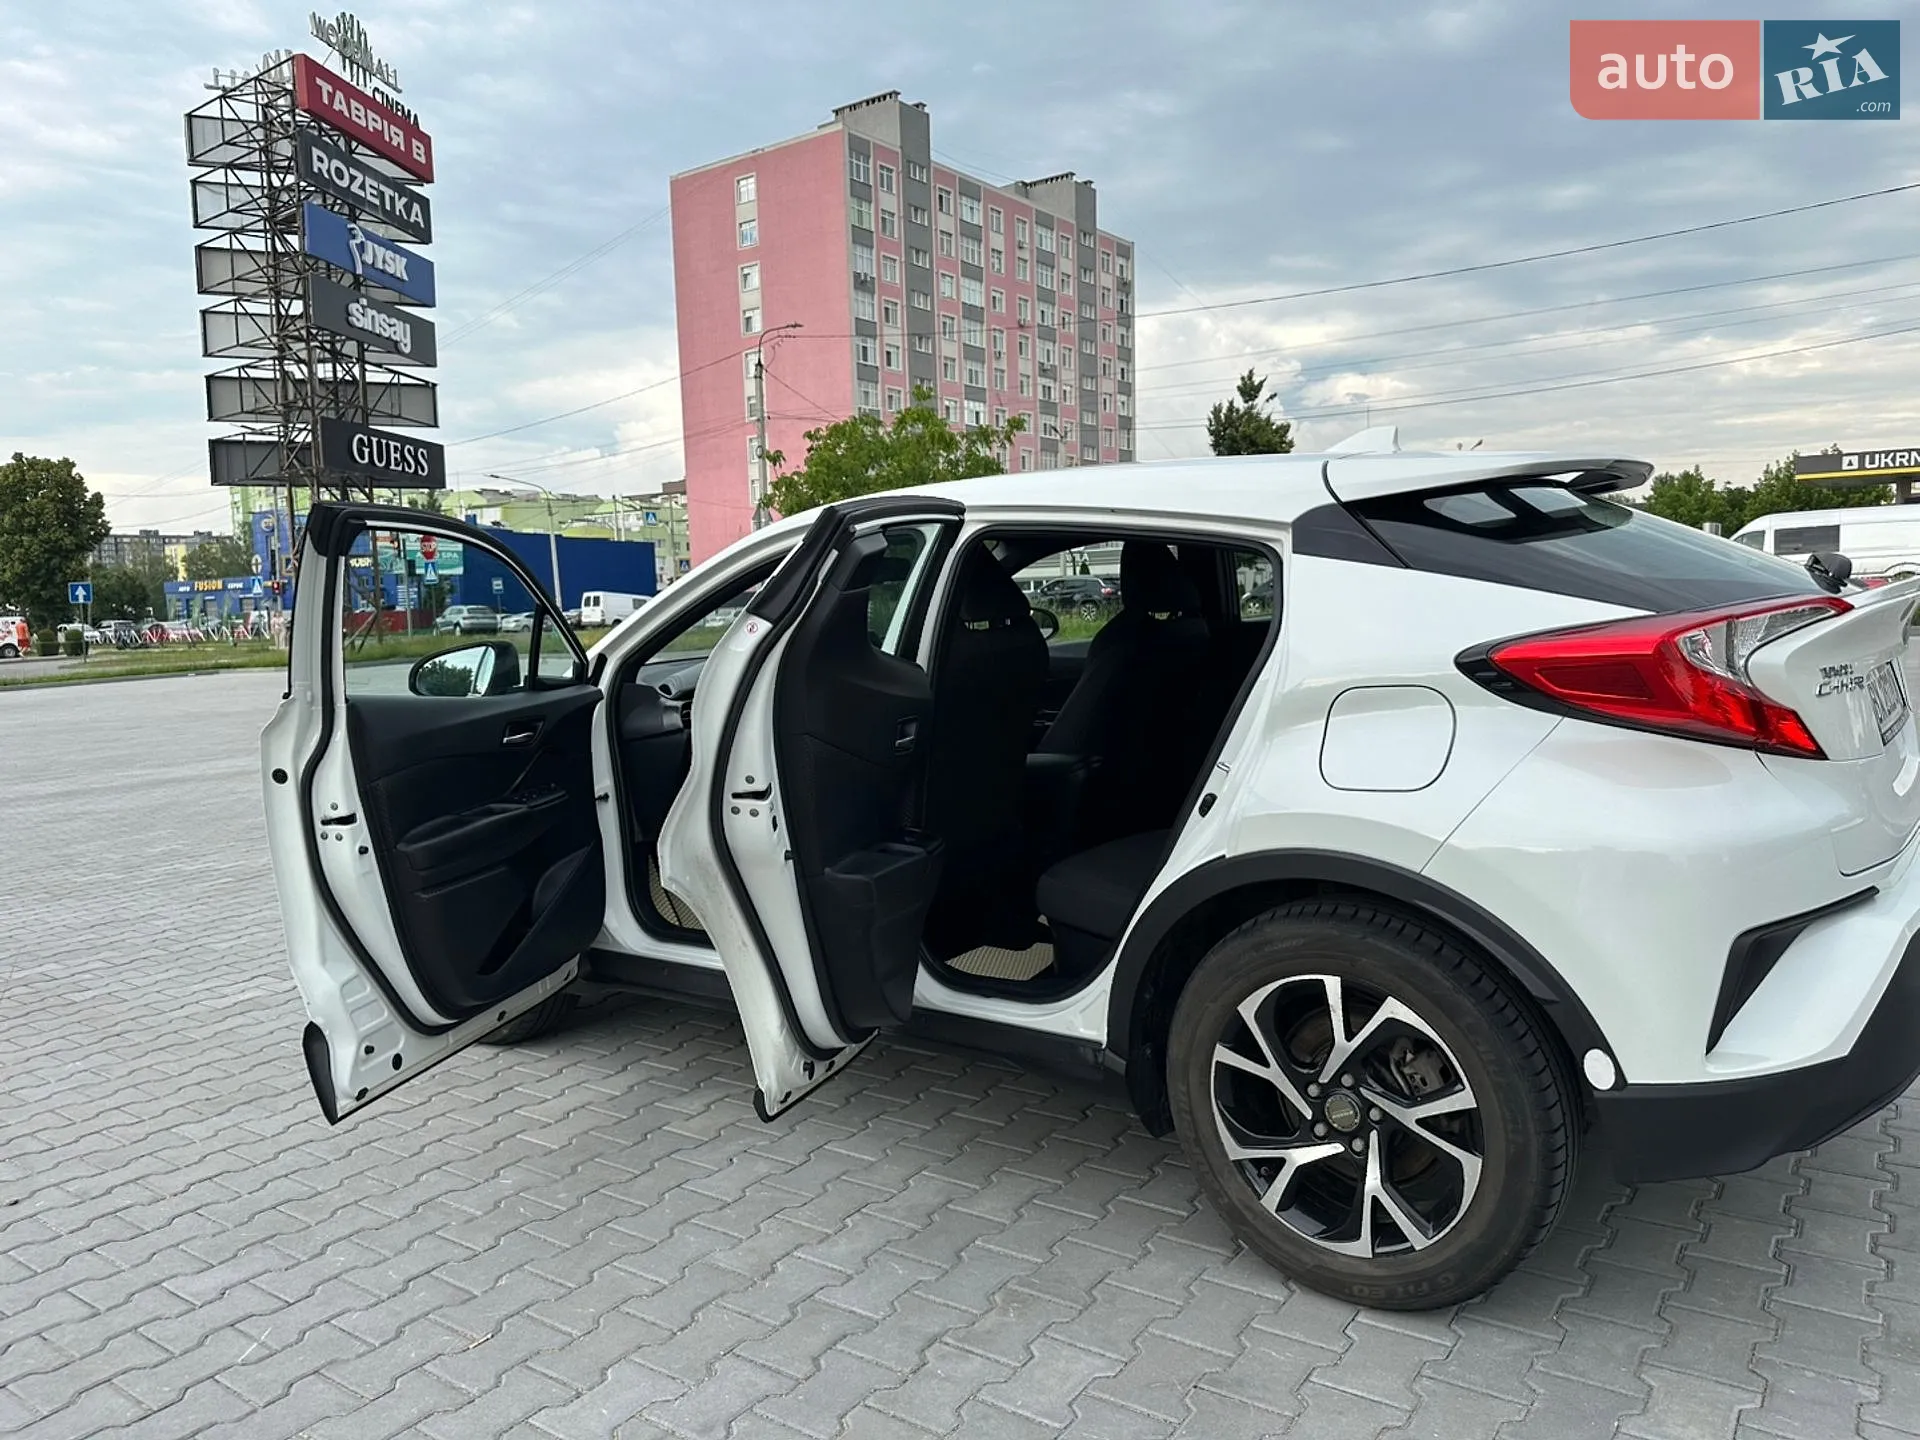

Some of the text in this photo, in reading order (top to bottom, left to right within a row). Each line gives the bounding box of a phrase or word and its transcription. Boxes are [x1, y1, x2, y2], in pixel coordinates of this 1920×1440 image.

[315, 78, 426, 164] ТАВРІЯ В
[372, 86, 421, 129] CINEMA
[311, 147, 424, 228] ROZETKA
[363, 241, 408, 281] JYSK
[347, 297, 411, 354] sinsay
[352, 433, 429, 476] GUESS
[422, 541, 437, 551] STOP
[194, 580, 223, 591] FUSION
